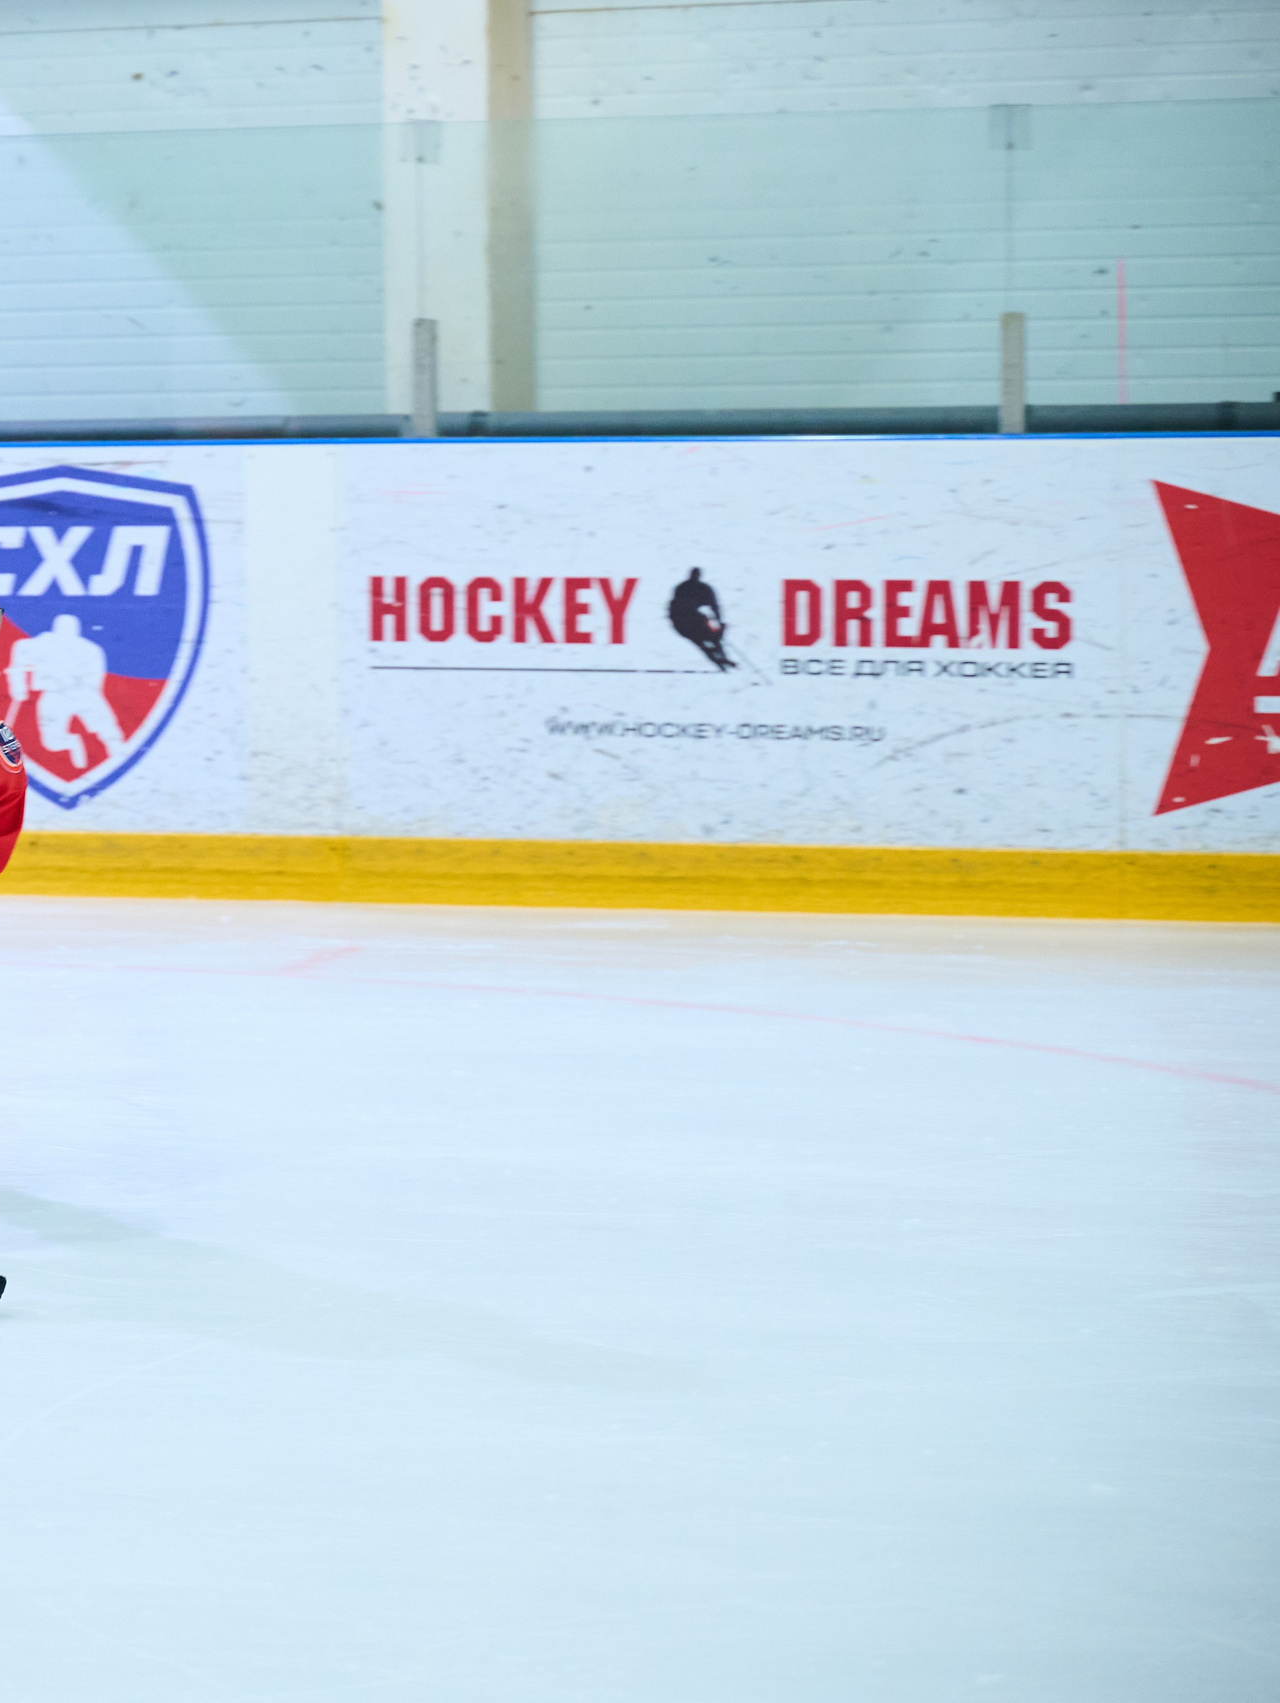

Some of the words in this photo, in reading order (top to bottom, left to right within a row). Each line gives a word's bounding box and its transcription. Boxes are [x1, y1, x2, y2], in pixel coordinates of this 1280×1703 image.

[368, 576, 639, 645] HOCKEY
[781, 578, 1075, 650] DREAMS
[780, 658, 846, 676] ВСЕ
[851, 659, 925, 678] ДЛЯ
[933, 660, 1075, 679] ХОККЕЯ
